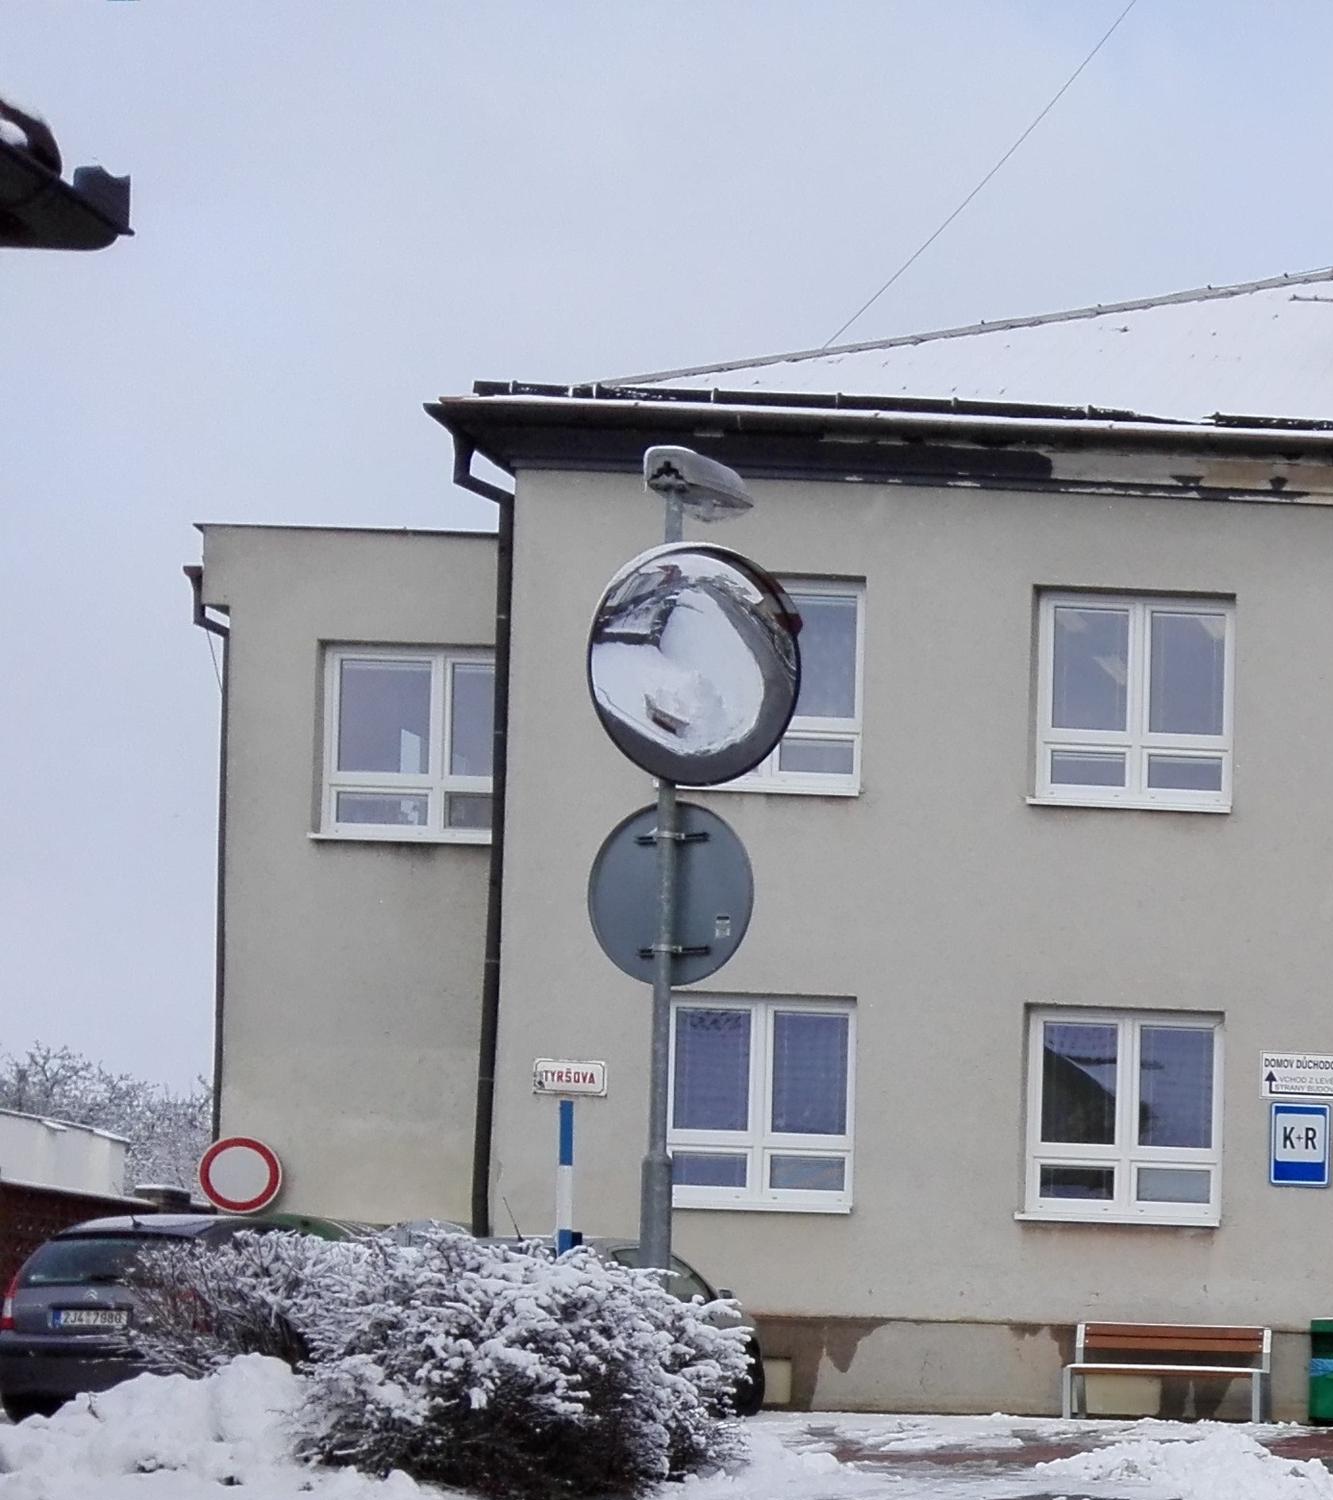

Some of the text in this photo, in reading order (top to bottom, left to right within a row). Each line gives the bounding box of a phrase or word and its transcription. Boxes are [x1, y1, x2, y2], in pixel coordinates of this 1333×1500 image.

[1264, 1058, 1294, 1069] DOMOV
[544, 1067, 596, 1085] TYRŠOVA
[1283, 1126, 1317, 1150] K+R
